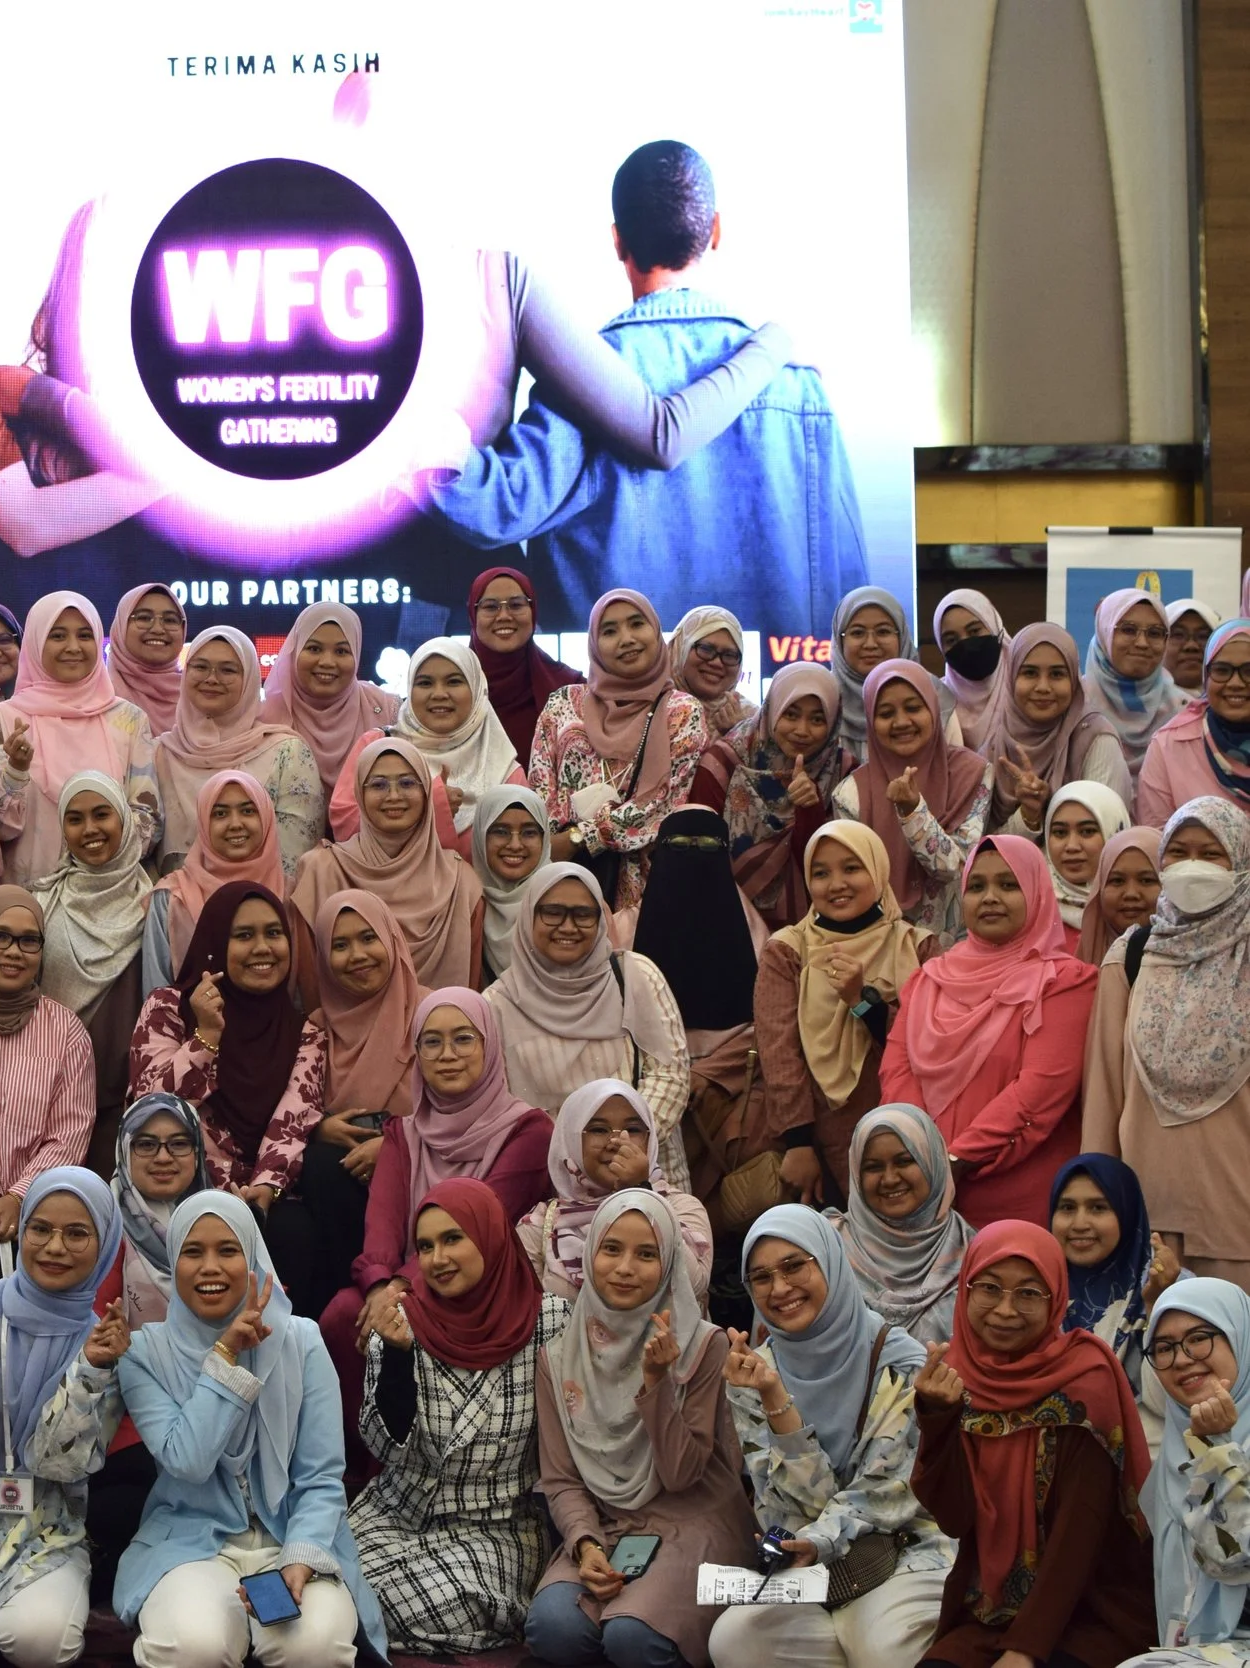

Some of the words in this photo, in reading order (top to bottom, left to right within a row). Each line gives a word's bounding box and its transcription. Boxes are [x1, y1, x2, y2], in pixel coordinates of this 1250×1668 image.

[167, 54, 276, 77] TERIMA
[293, 52, 380, 74] KASIH
[162, 245, 388, 343] WFG
[176, 376, 275, 403] WOMEN'S
[279, 375, 379, 401] FERTILITY
[220, 417, 337, 444] GATHERING
[170, 581, 230, 606] OUR
[241, 578, 411, 605] PARTNERS:
